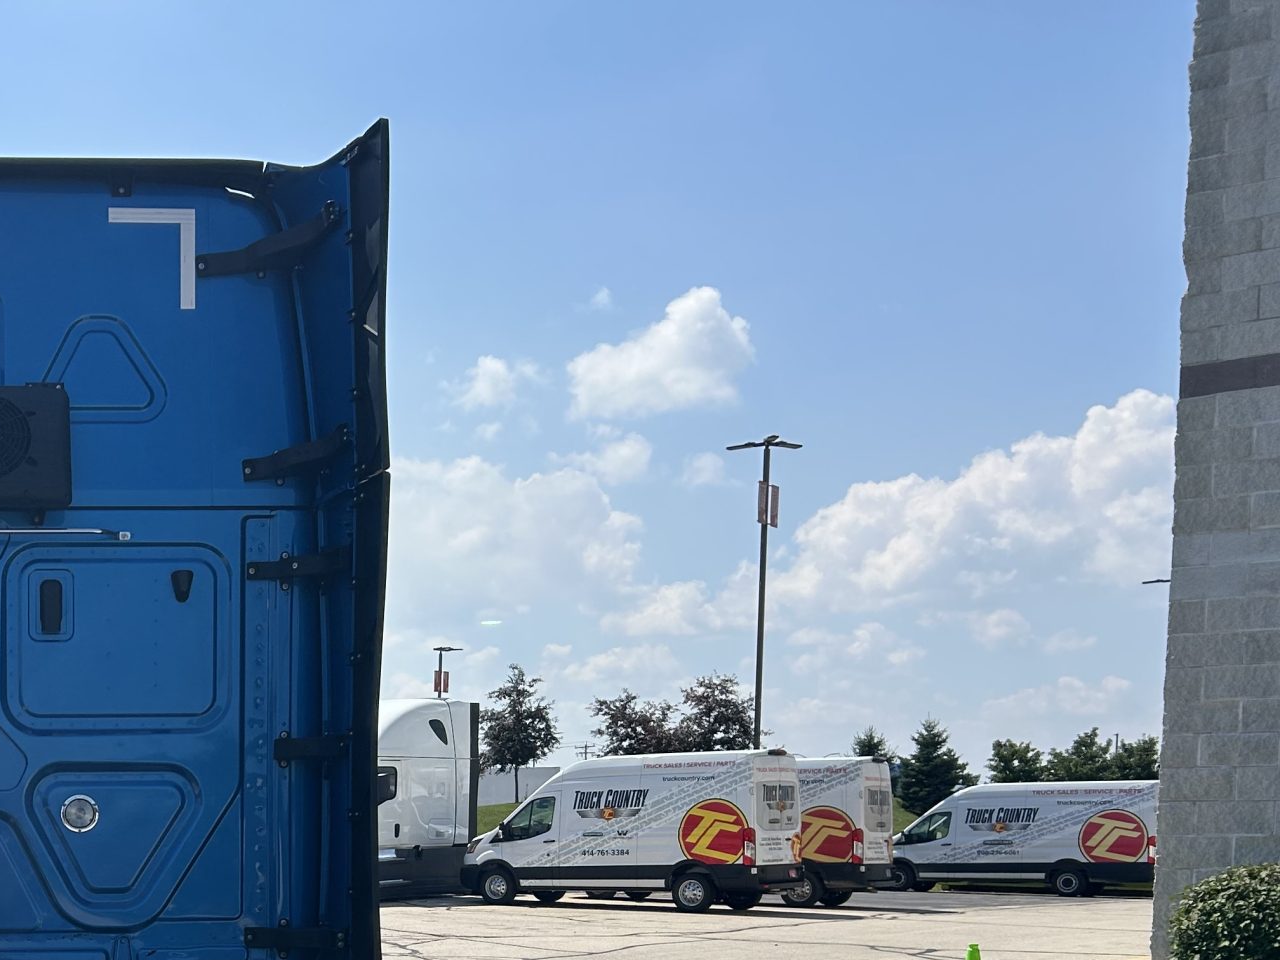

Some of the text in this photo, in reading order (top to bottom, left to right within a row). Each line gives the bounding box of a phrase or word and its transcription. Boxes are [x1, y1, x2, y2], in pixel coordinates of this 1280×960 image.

[573, 788, 649, 809] TRUCK COUNTRY
[965, 807, 1040, 824] TRUCK COUNTRY
